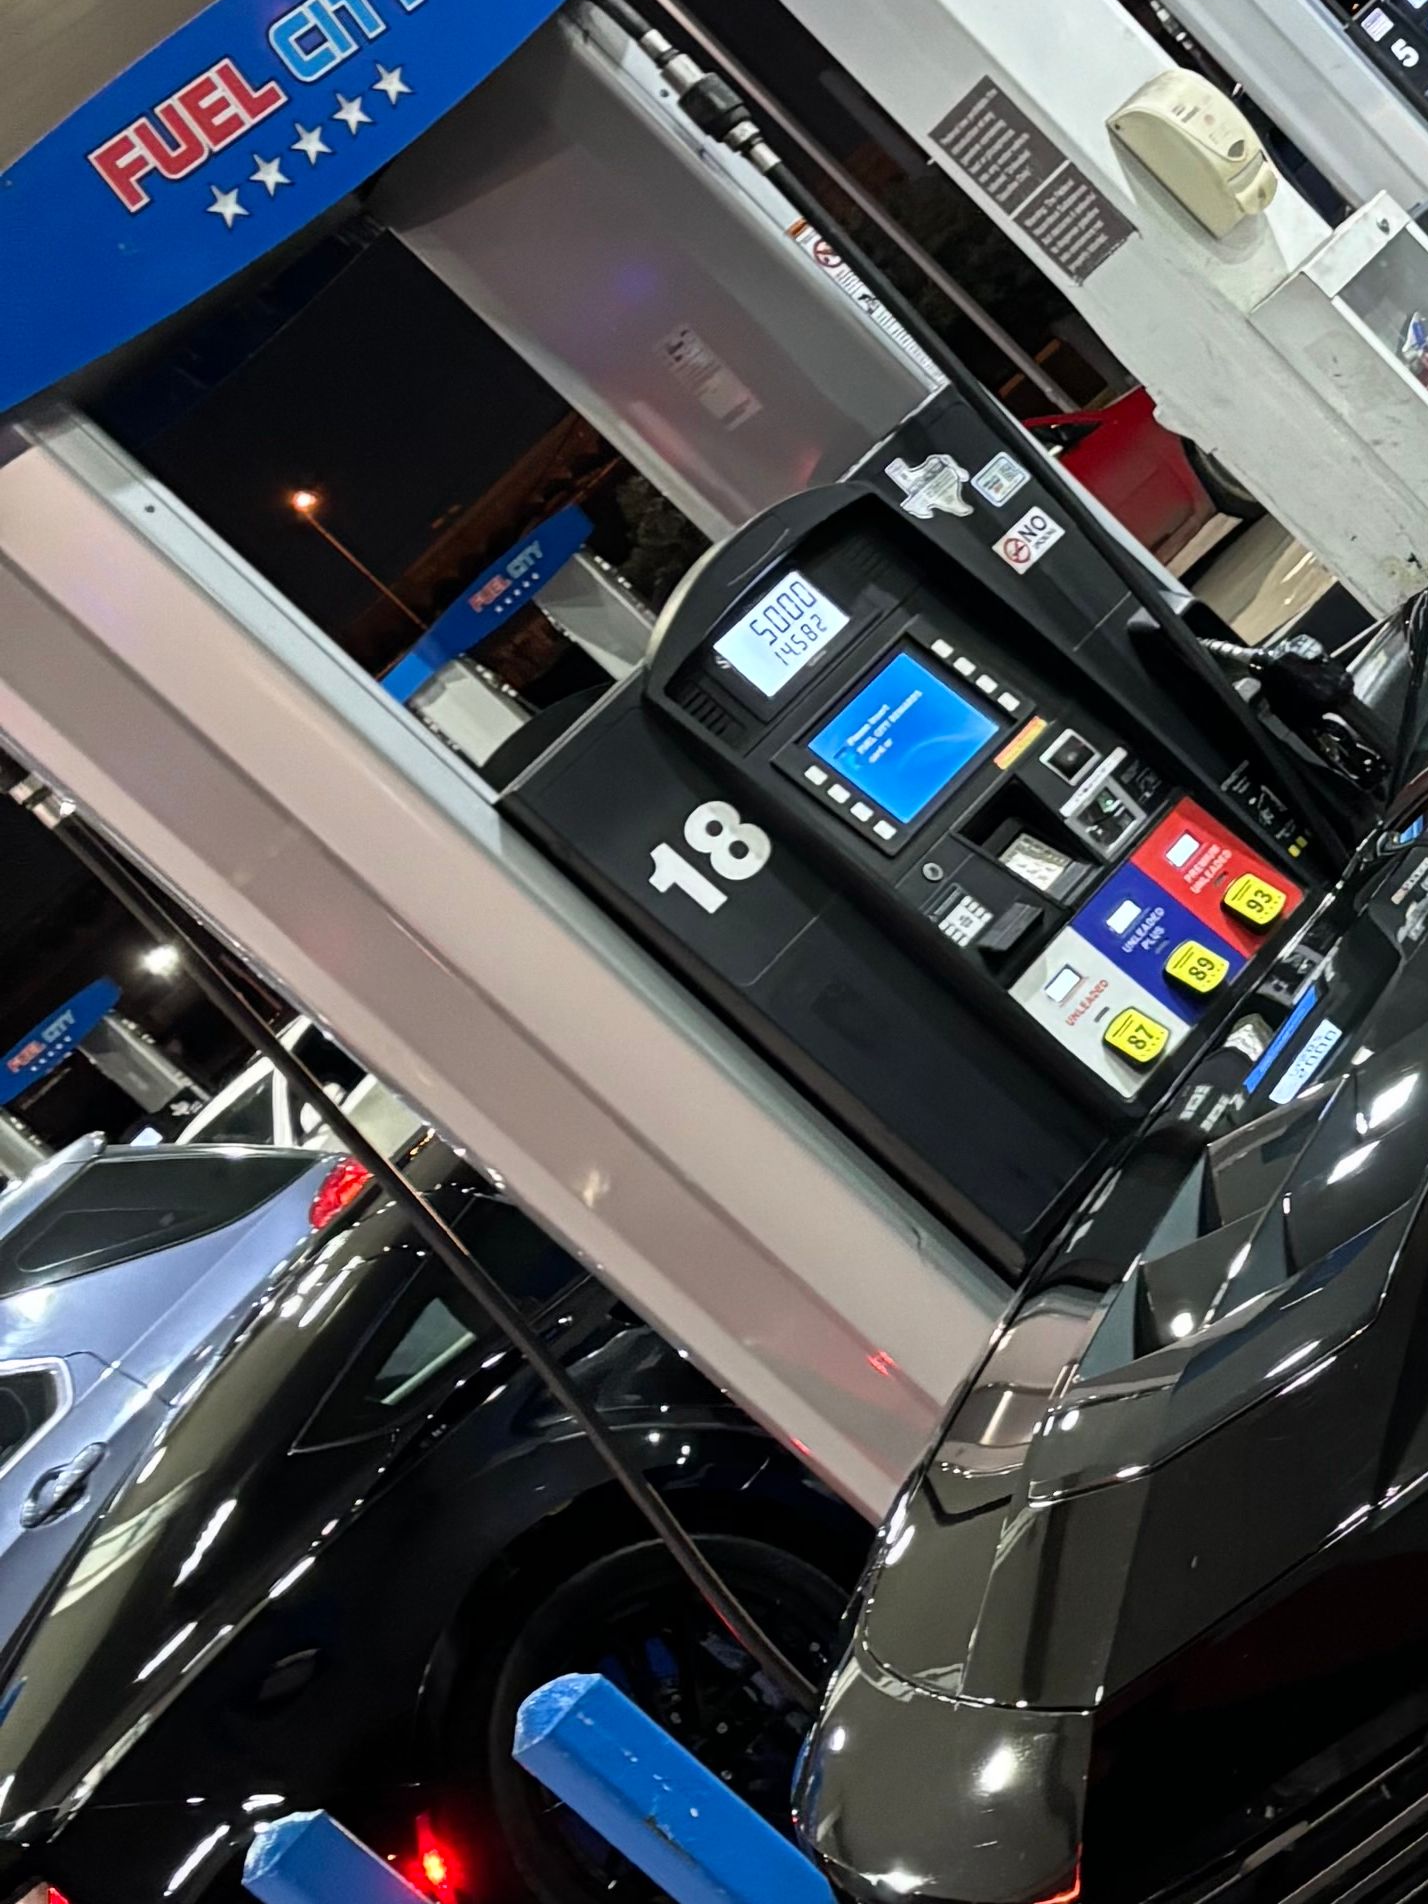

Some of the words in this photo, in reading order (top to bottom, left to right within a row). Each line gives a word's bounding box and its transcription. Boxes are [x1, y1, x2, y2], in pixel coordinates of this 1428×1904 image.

[1390, 38, 1420, 68] 5
[87, 57, 289, 213] FUEL
[1018, 515, 1047, 543] NO
[648, 800, 771, 914] 18
[1189, 849, 1233, 894] UNLEADED
[1246, 889, 1273, 914] 93
[1121, 906, 1165, 953] UNLEADED
[1140, 926, 1166, 951] PLUS
[1188, 957, 1216, 981] 89
[1065, 979, 1109, 1026] UNLEADED
[1127, 1025, 1154, 1051] 87
